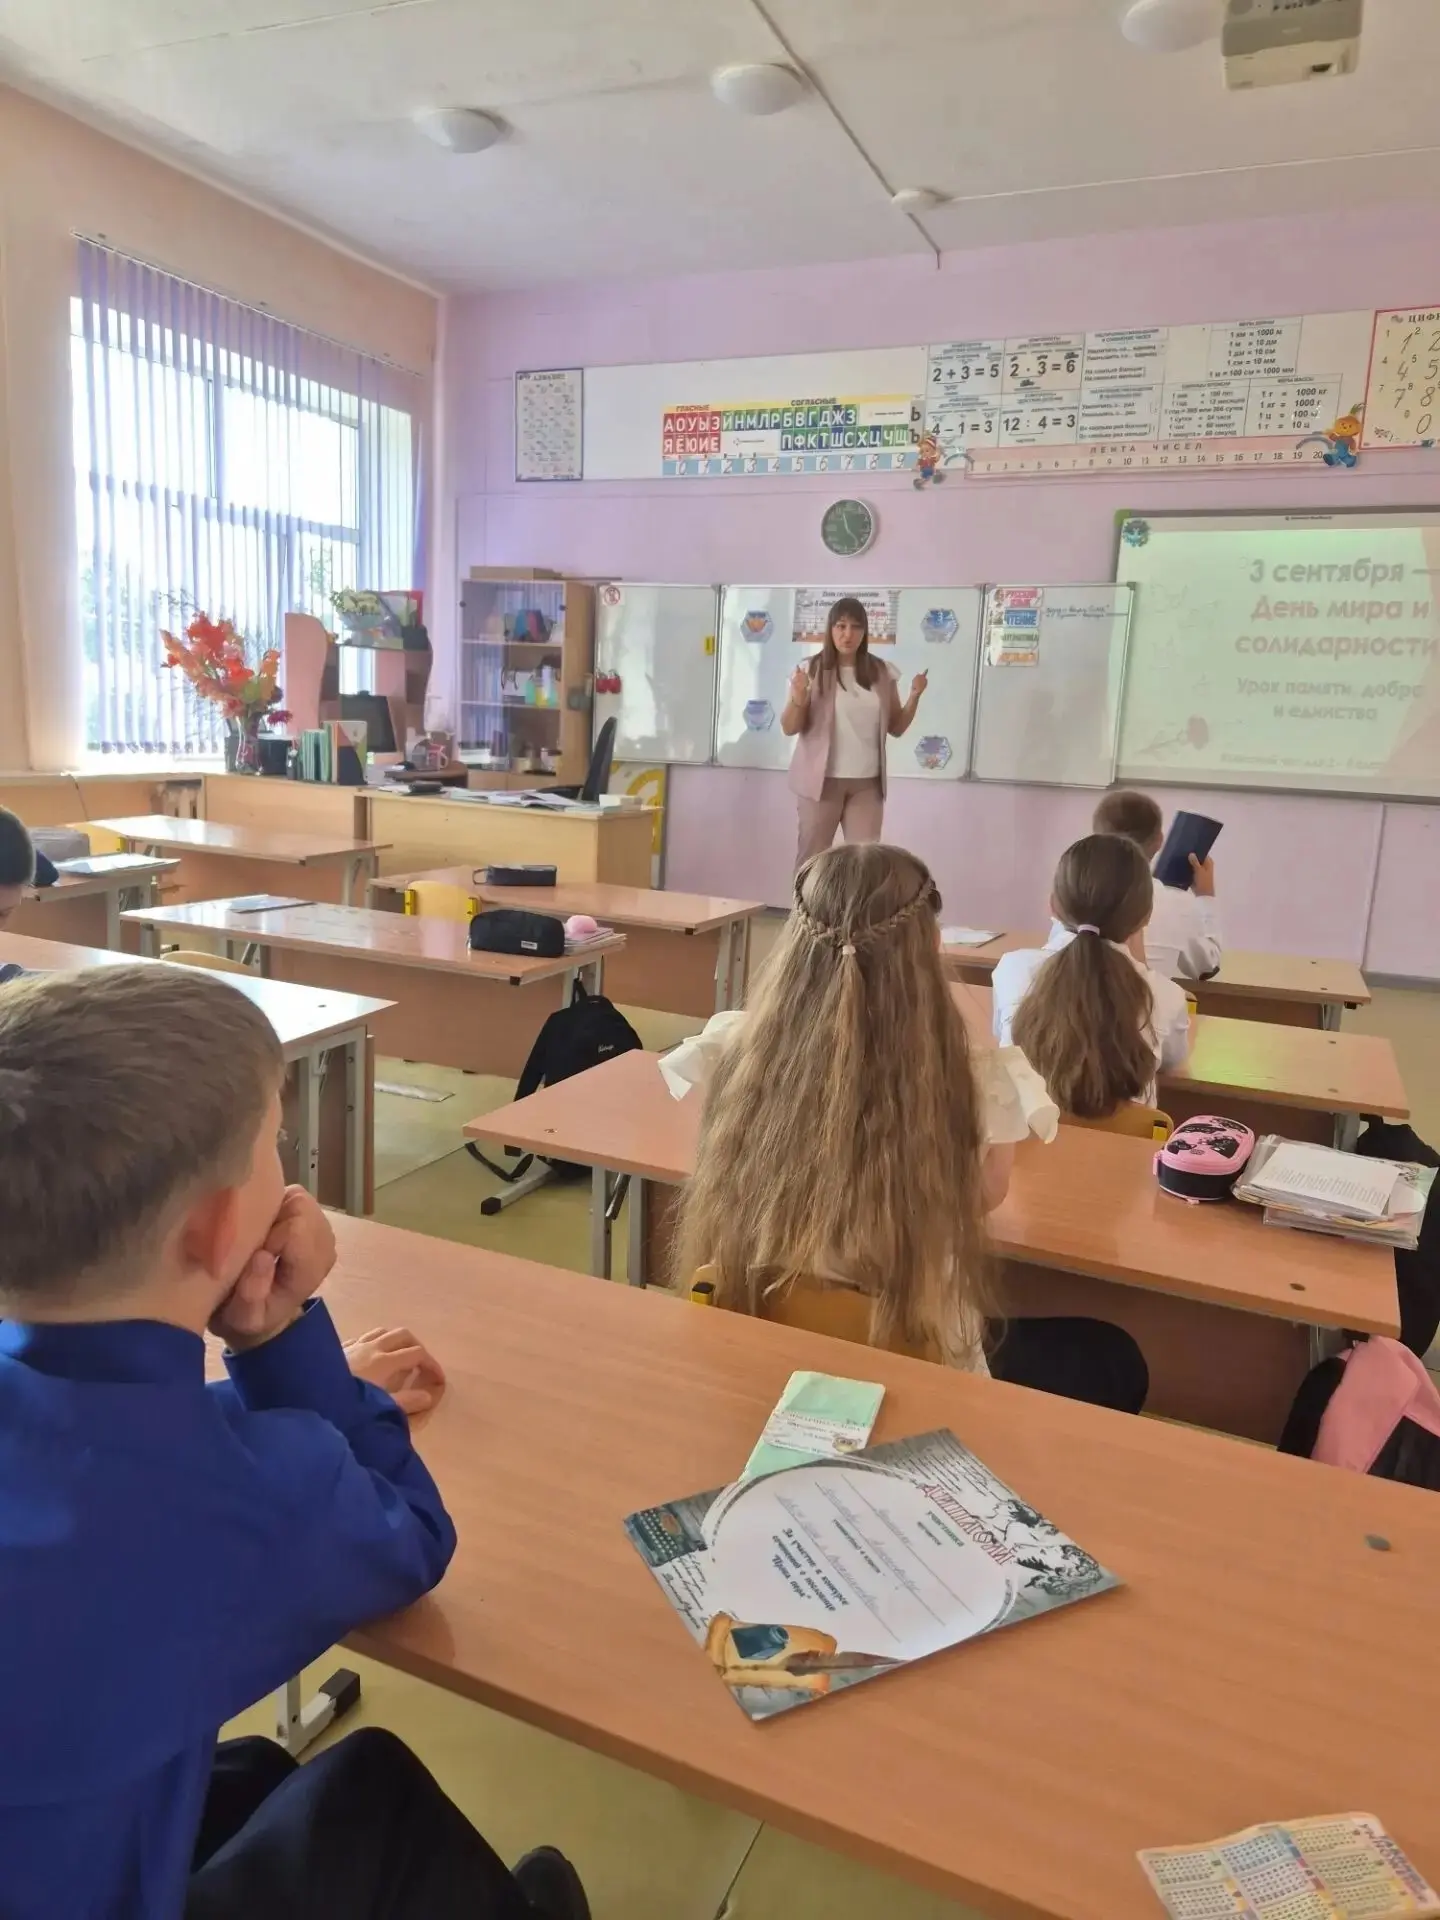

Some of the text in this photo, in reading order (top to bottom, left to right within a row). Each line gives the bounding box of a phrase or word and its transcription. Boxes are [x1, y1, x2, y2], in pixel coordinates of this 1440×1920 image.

[1414, 327, 1421, 335] 2
[932, 367, 942, 382] 2
[961, 365, 970, 380] 3
[990, 363, 999, 378] 5
[1010, 363, 1019, 377] 2
[1037, 361, 1046, 375] 3
[1066, 359, 1075, 373] 6
[1397, 361, 1408, 381] 4
[1412, 354, 1417, 363] 5
[1424, 359, 1439, 380] 5
[1296, 388, 1316, 396] 1000
[1394, 388, 1406, 408] 7
[1420, 386, 1435, 407] 8
[791, 398, 837, 406] СОГЛАСНЫЕ
[931, 423, 940, 435] 4
[958, 422, 965, 434] 1
[984, 420, 993, 434] 3
[1003, 417, 1020, 431] 12
[1038, 415, 1048, 429] 4
[1066, 414, 1076, 428] 3
[1416, 413, 1432, 434] 0
[1090, 445, 1136, 454] ЛЕНТА
[1123, 458, 1132, 466] 10
[1160, 456, 1168, 464] 12
[1197, 455, 1206, 463] 14
[1234, 453, 1244, 461] 16
[1254, 453, 1263, 461] 17
[1273, 452, 1283, 460] 18
[1313, 451, 1323, 459] 20
[795, 457, 803, 472] 5
[820, 456, 828, 471] 6
[870, 454, 878, 470] 8
[897, 453, 904, 468] 9
[1250, 559, 1265, 583] 3
[1273, 557, 1404, 590] сентября
[1250, 595, 1430, 625] День мира и
[1237, 677, 1280, 696] Урок
[1274, 705, 1378, 720] и единства
[926, 1510, 965, 1547] участника
[772, 1536, 801, 1569] сочинений
[805, 1577, 836, 1612] пословице
[782, 1528, 793, 1538] За
[792, 1540, 816, 1568] участие
[822, 1576, 849, 1605] конкурсе
